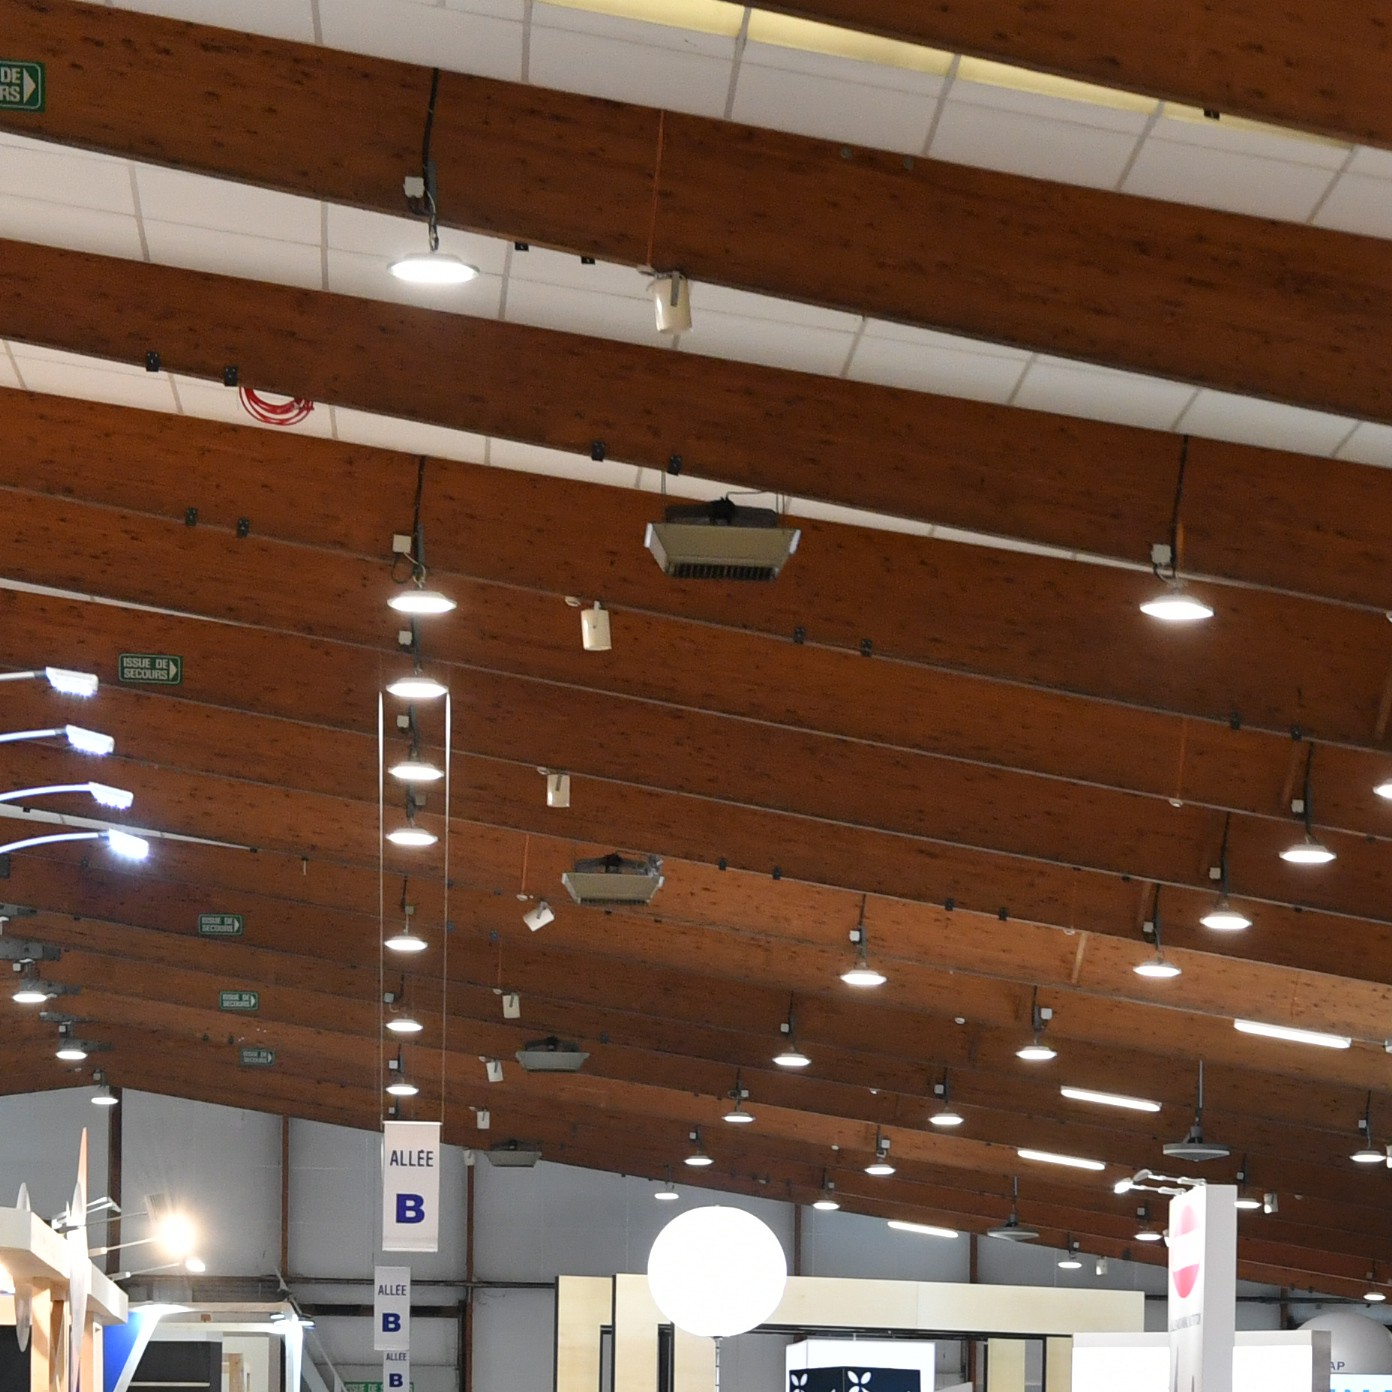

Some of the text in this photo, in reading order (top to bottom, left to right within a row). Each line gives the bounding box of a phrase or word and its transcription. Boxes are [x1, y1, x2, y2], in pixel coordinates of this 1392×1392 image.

[123, 657, 168, 669] ISSUE DE
[124, 668, 168, 679] SECOURS
[390, 1149, 434, 1167] ALLÉE
[395, 1193, 425, 1223] B
[378, 1283, 407, 1296] ALLÉE
[381, 1312, 401, 1332] B
[389, 1373, 403, 1388] B
